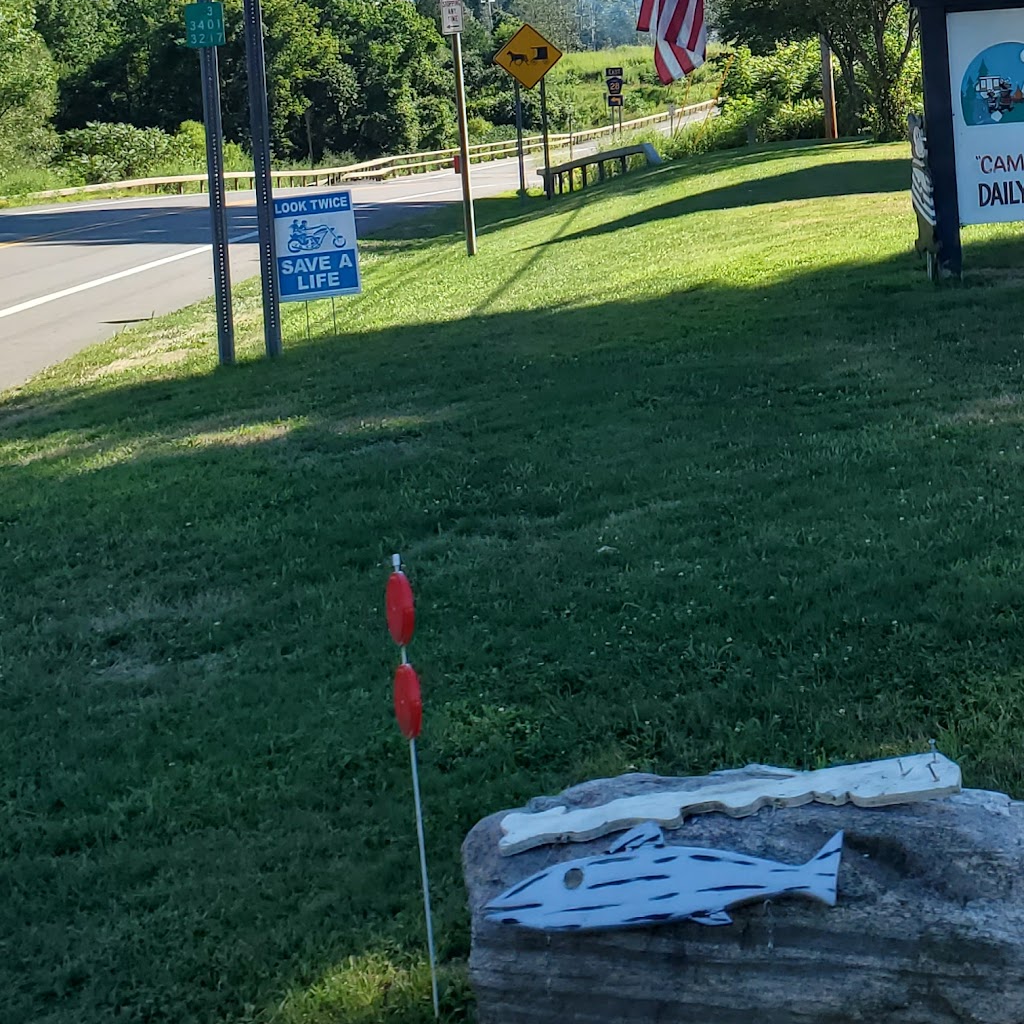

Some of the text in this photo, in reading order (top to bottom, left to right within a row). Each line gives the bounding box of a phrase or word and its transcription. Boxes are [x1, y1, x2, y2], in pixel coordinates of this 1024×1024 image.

[207, 6, 213, 16] 3
[190, 19, 220, 31] 3401
[191, 33, 222, 44] 3217
[610, 82, 620, 91] 28
[274, 196, 348, 214] LOOK TWICE
[281, 253, 353, 275] SAVE A
[297, 272, 340, 290] LIFE
